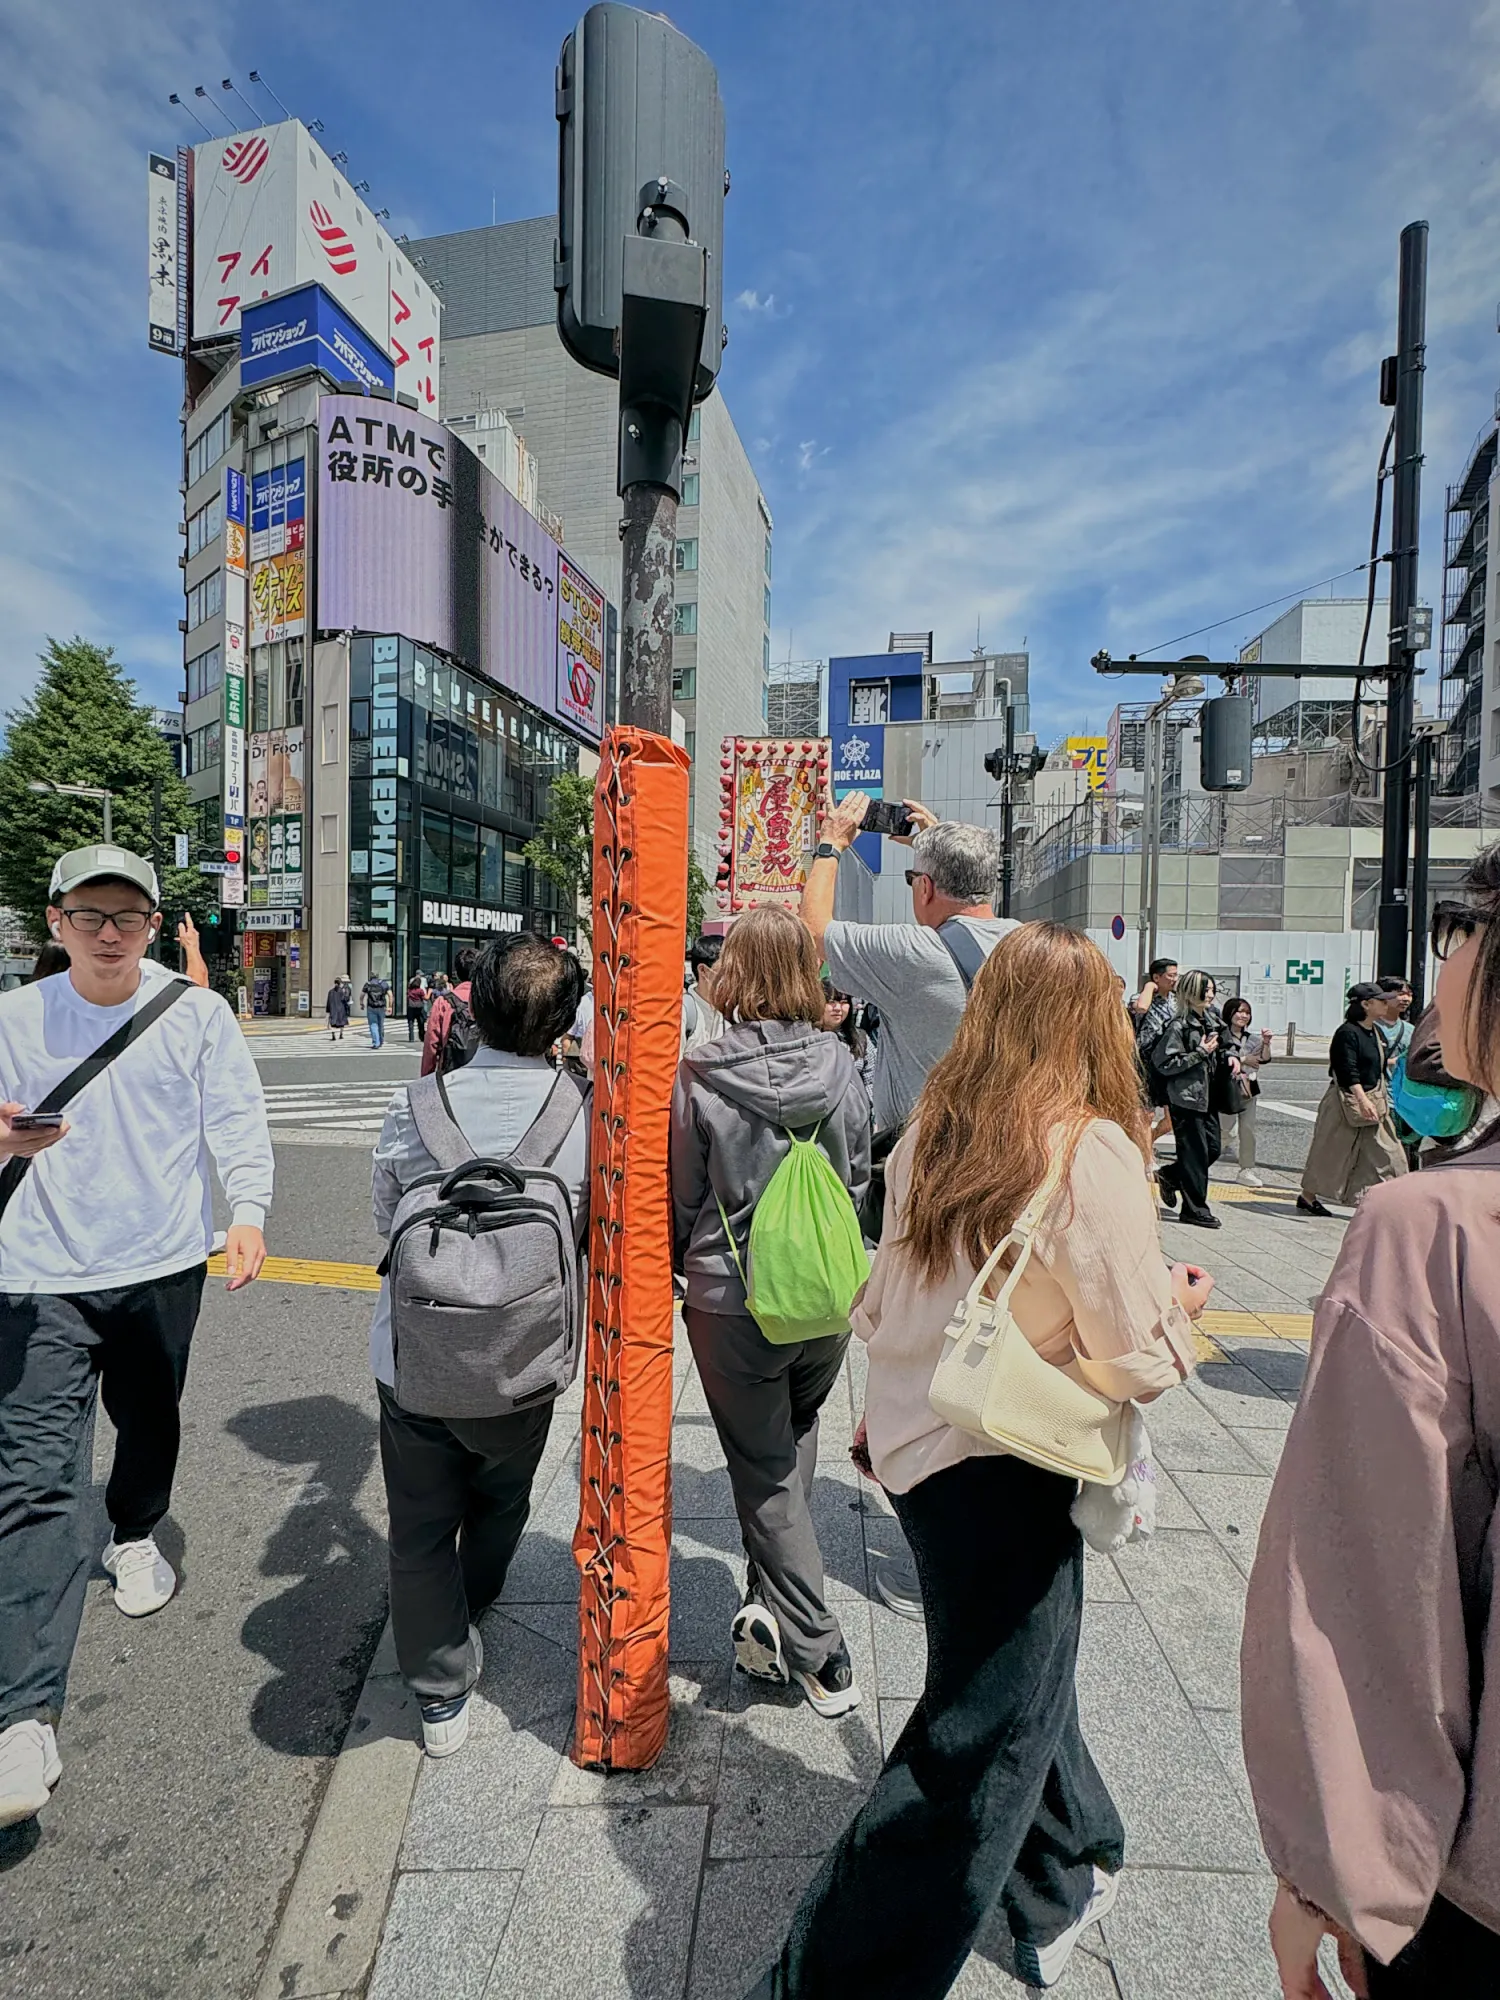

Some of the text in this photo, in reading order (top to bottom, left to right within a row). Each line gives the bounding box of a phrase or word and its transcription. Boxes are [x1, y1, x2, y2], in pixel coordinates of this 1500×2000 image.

[217, 244, 274, 284] アイ
[251, 318, 307, 353] アパマンショップ
[327, 415, 446, 472] ATMで
[328, 450, 454, 509] 役所の手
[294, 551, 304, 562] 5F
[560, 618, 602, 674] 携帯電話
[853, 687, 887, 724] 靴
[272, 739, 304, 757] Foot
[758, 760, 801, 768] YATAIEN
[833, 769, 882, 781] HOE-PLAZA
[230, 816, 239, 825] 1F
[754, 884, 798, 893] SHINJUKU
[422, 900, 460, 927] BLUE
[461, 905, 523, 933] ELEPHANT
